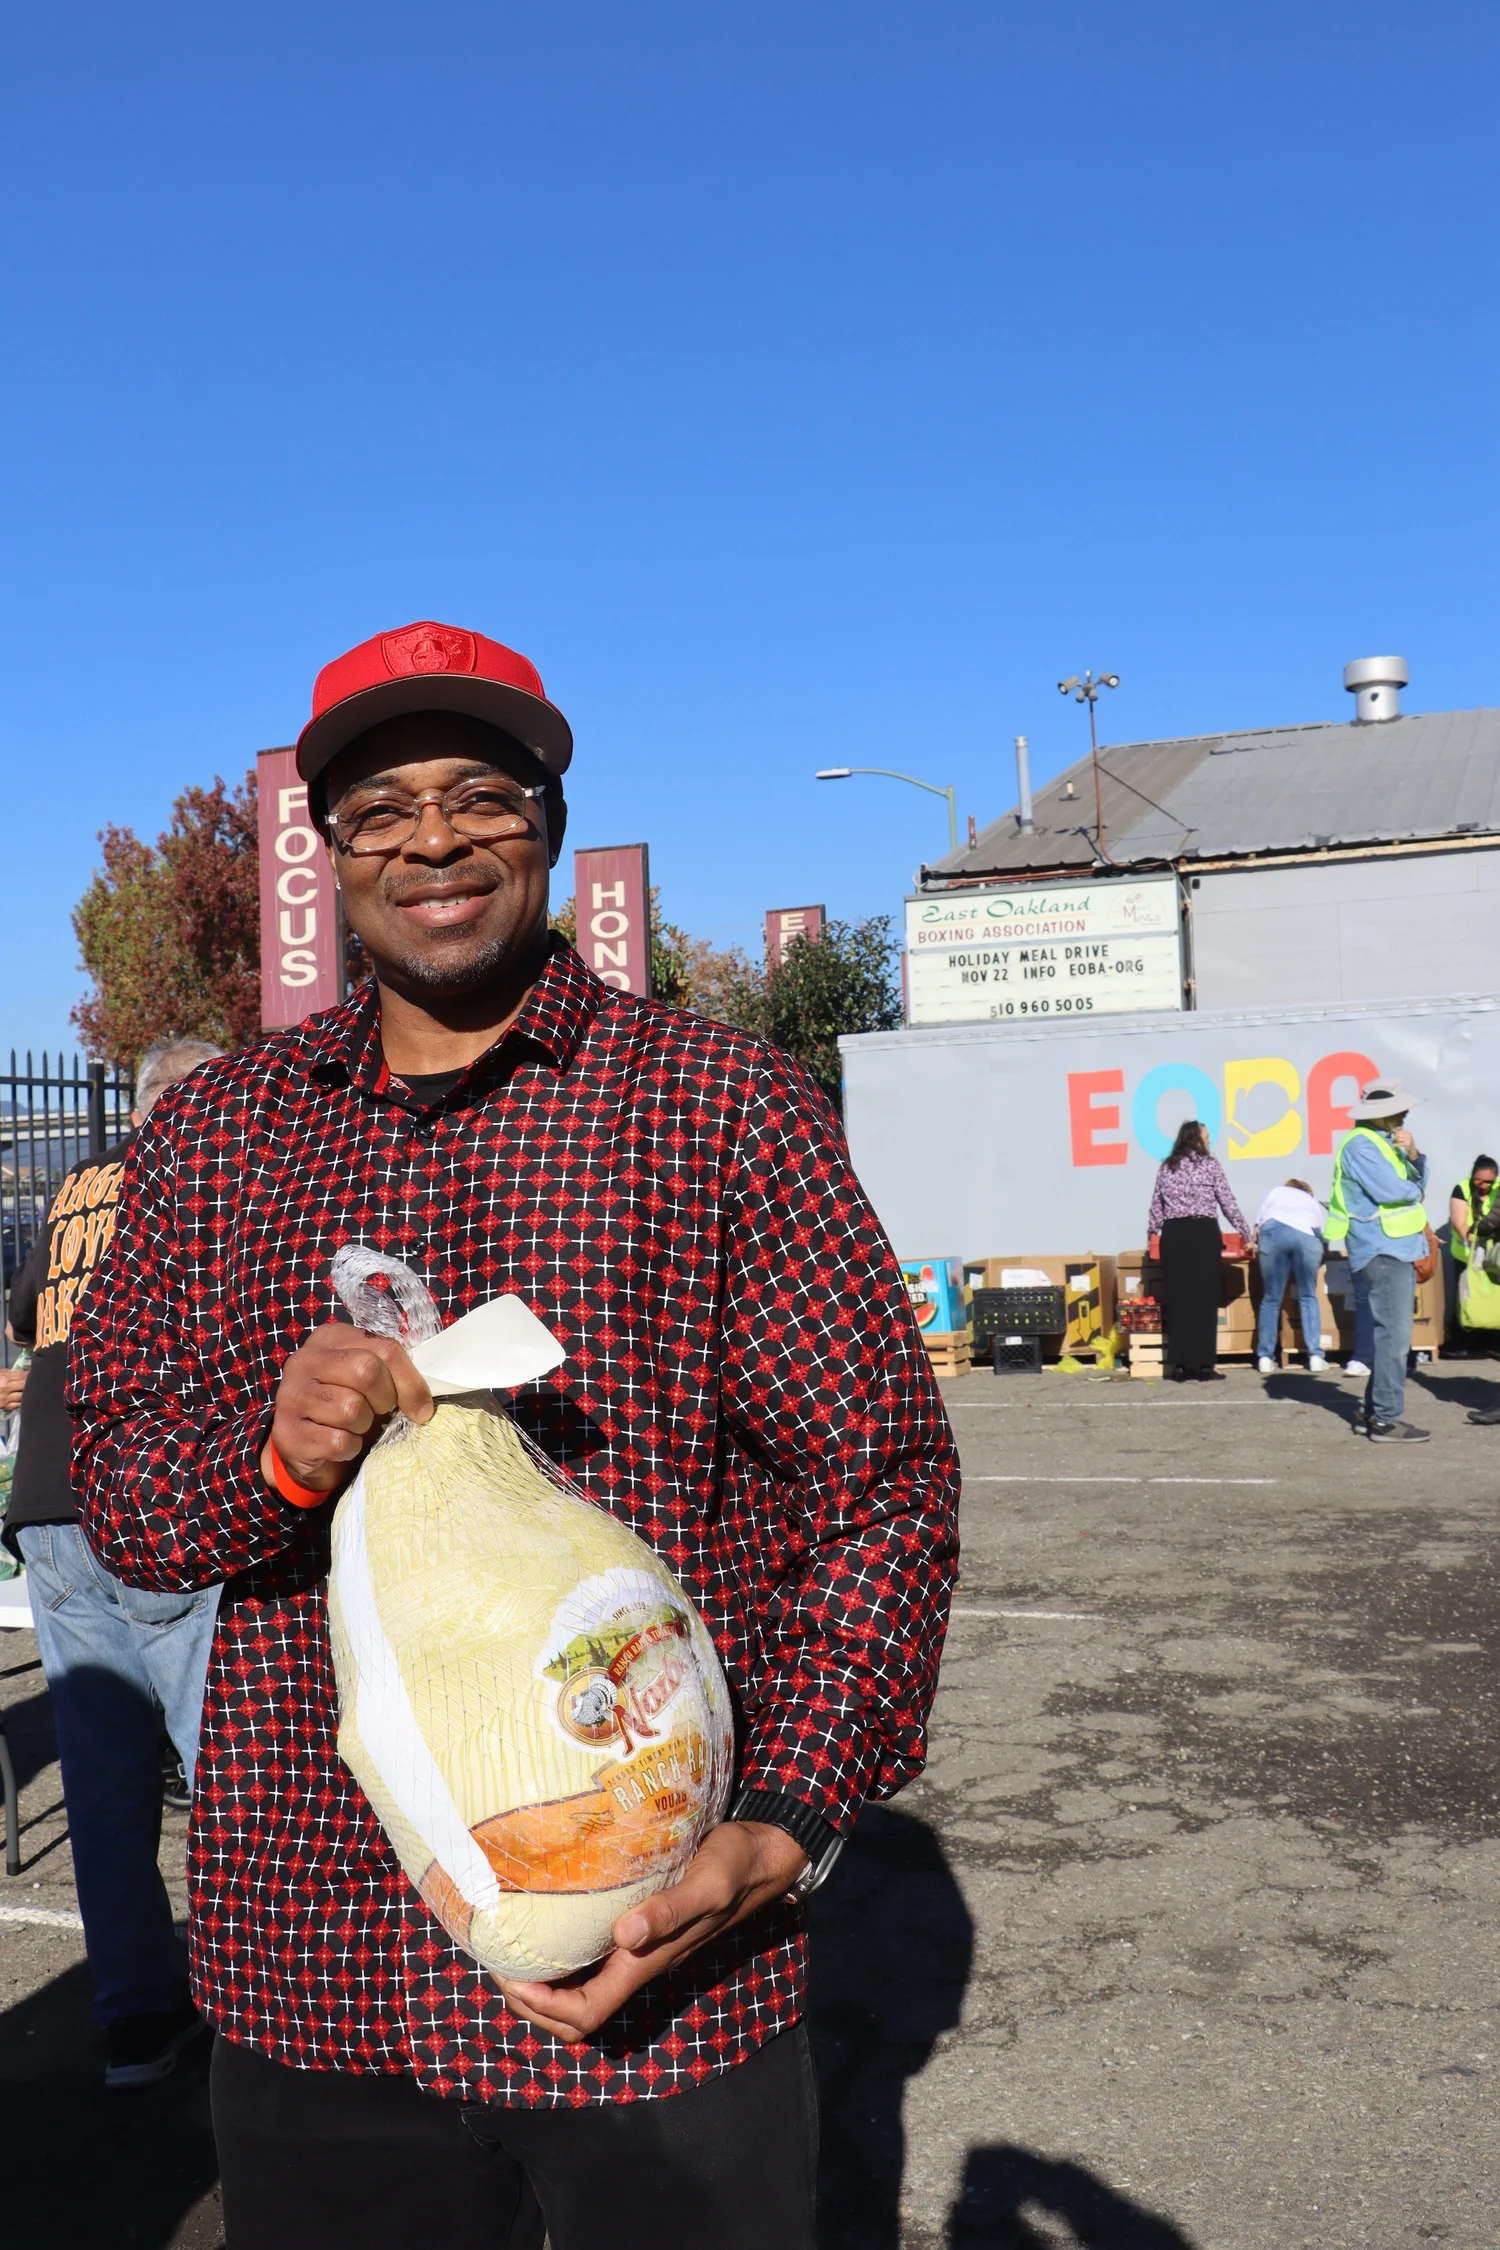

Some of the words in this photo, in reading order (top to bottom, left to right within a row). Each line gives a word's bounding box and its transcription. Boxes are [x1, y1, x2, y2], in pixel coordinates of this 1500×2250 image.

[275, 785, 319, 988] FOCUS
[922, 905, 978, 923] East
[987, 896, 1090, 918] Oakland
[918, 928, 974, 944] BOXING
[983, 919, 1086, 938] ASSOCIATION
[949, 951, 1009, 968] HOLIDAY
[1019, 948, 1057, 963] MEAL
[1065, 944, 1109, 959] DRIVE
[962, 968, 987, 984] NOV
[993, 968, 1008, 981] 22
[1023, 965, 1056, 980] INFO
[989, 1002, 1014, 1018] 510
[1020, 1000, 1049, 1014] 960
[1067, 1051, 1380, 1167] EOBA
[612, 1754, 682, 1813] RANCH
[654, 1791, 687, 1812] YOUNG
